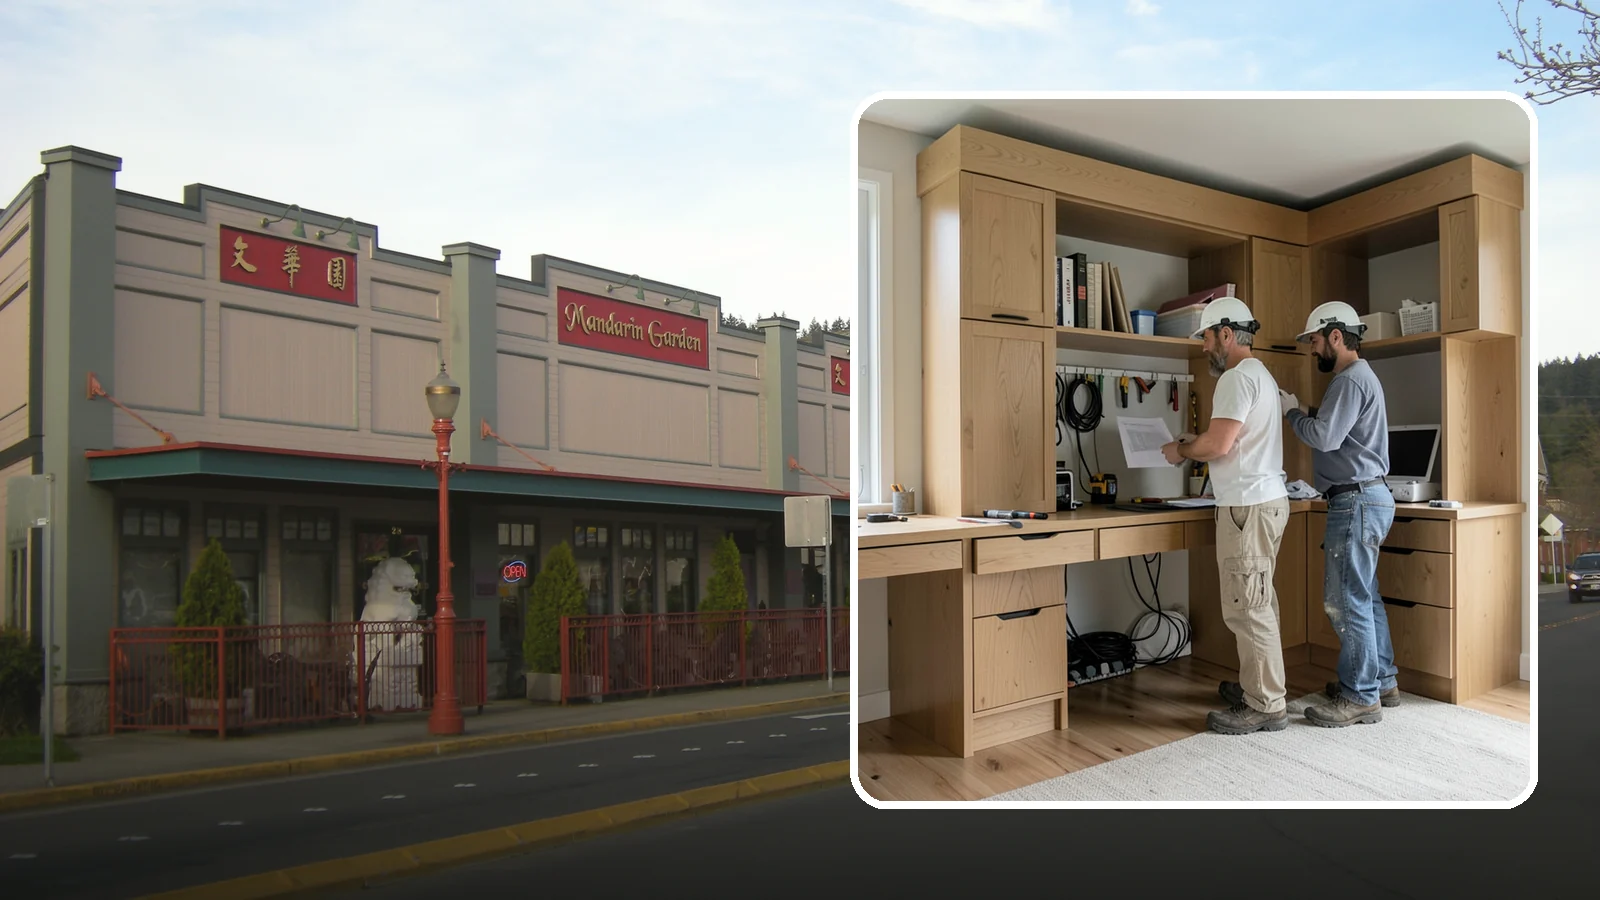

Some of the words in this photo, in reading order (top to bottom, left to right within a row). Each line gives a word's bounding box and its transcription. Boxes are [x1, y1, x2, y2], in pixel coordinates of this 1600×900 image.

[231, 236, 346, 290] 文華園
[565, 303, 644, 340] Mandarin
[648, 320, 702, 352] Garden
[835, 363, 846, 386] 文
[503, 565, 527, 578] OPEN
